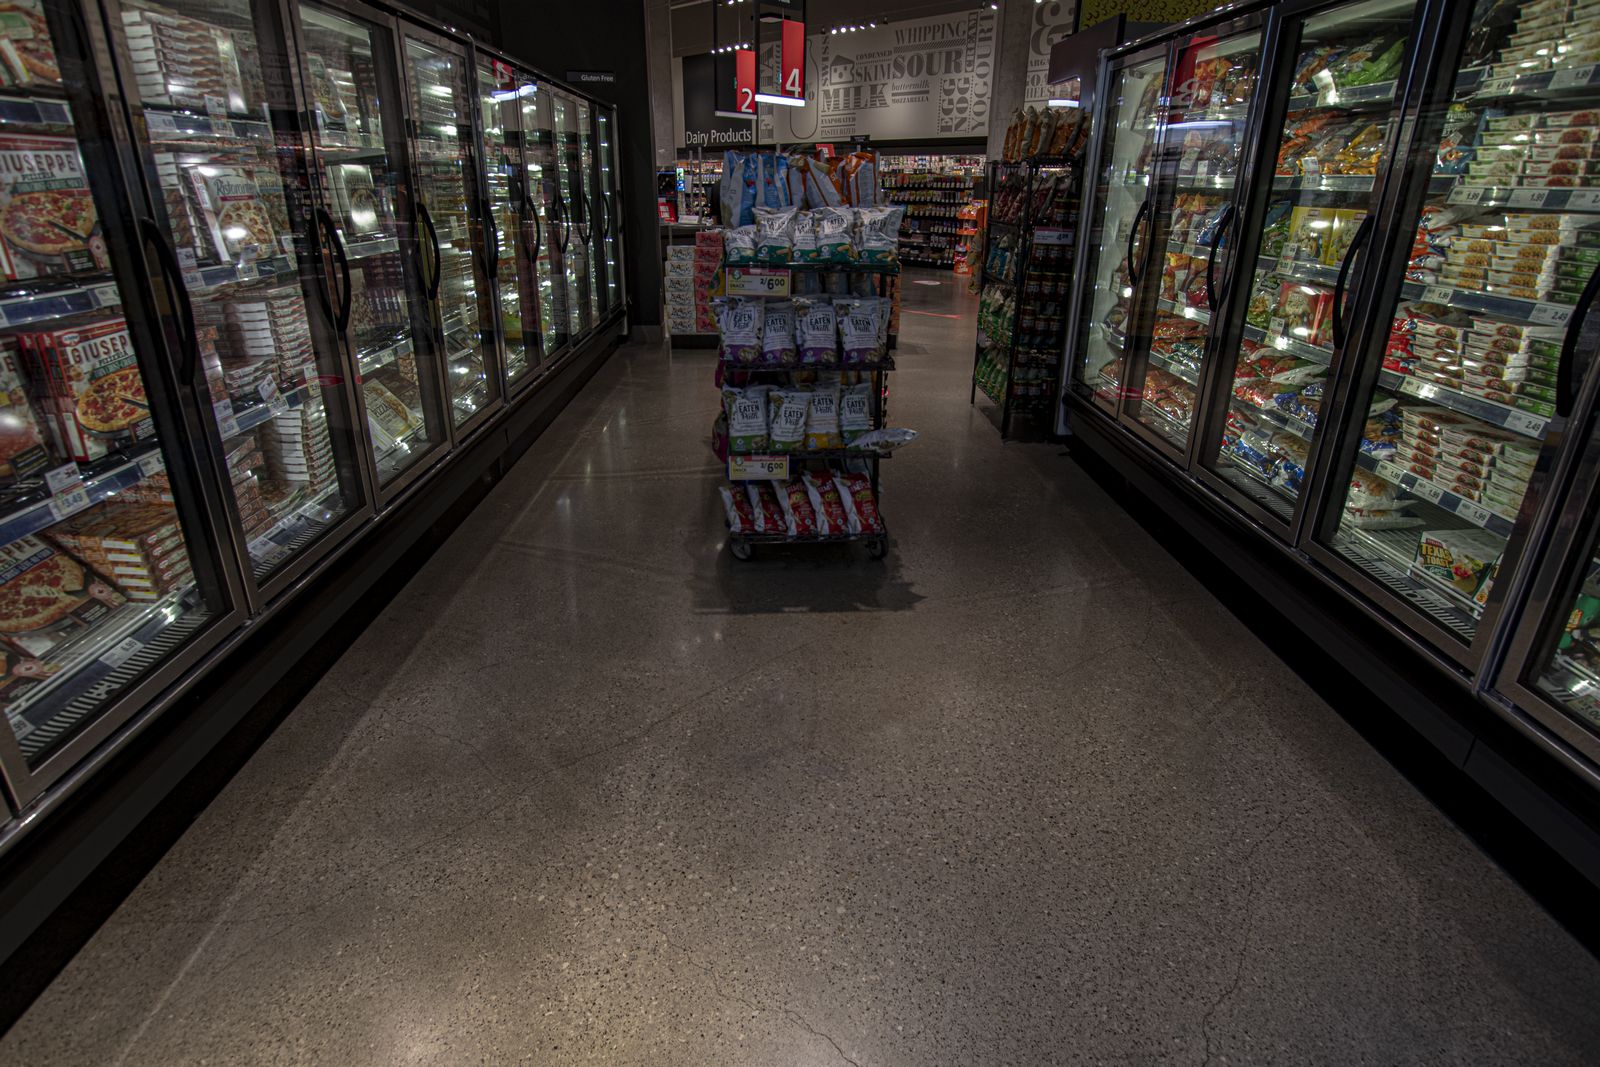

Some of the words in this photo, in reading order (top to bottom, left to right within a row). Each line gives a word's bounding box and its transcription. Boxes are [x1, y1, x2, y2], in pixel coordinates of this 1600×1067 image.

[895, 21, 966, 45] WHIPPING
[855, 63, 892, 82] SKIM
[893, 50, 963, 79] SOUR
[971, 15, 993, 132] YOGOURT
[786, 68, 801, 98] 4
[741, 88, 752, 112] 2
[821, 83, 889, 112] MILK
[940, 79, 955, 132] EGG
[954, 77, 970, 132] NOG
[686, 131, 709, 147] Dairy
[711, 128, 752, 143] Products
[0, 154, 77, 173] IUSEPPE
[810, 318, 831, 326] EATEN
[71, 335, 128, 364] GIUSEP
[739, 403, 760, 413] EATEN
[812, 398, 834, 407] EATEN
[846, 400, 866, 409] EATEN
[783, 410, 803, 420] EATEN
[1420, 543, 1453, 563] TEXAS
